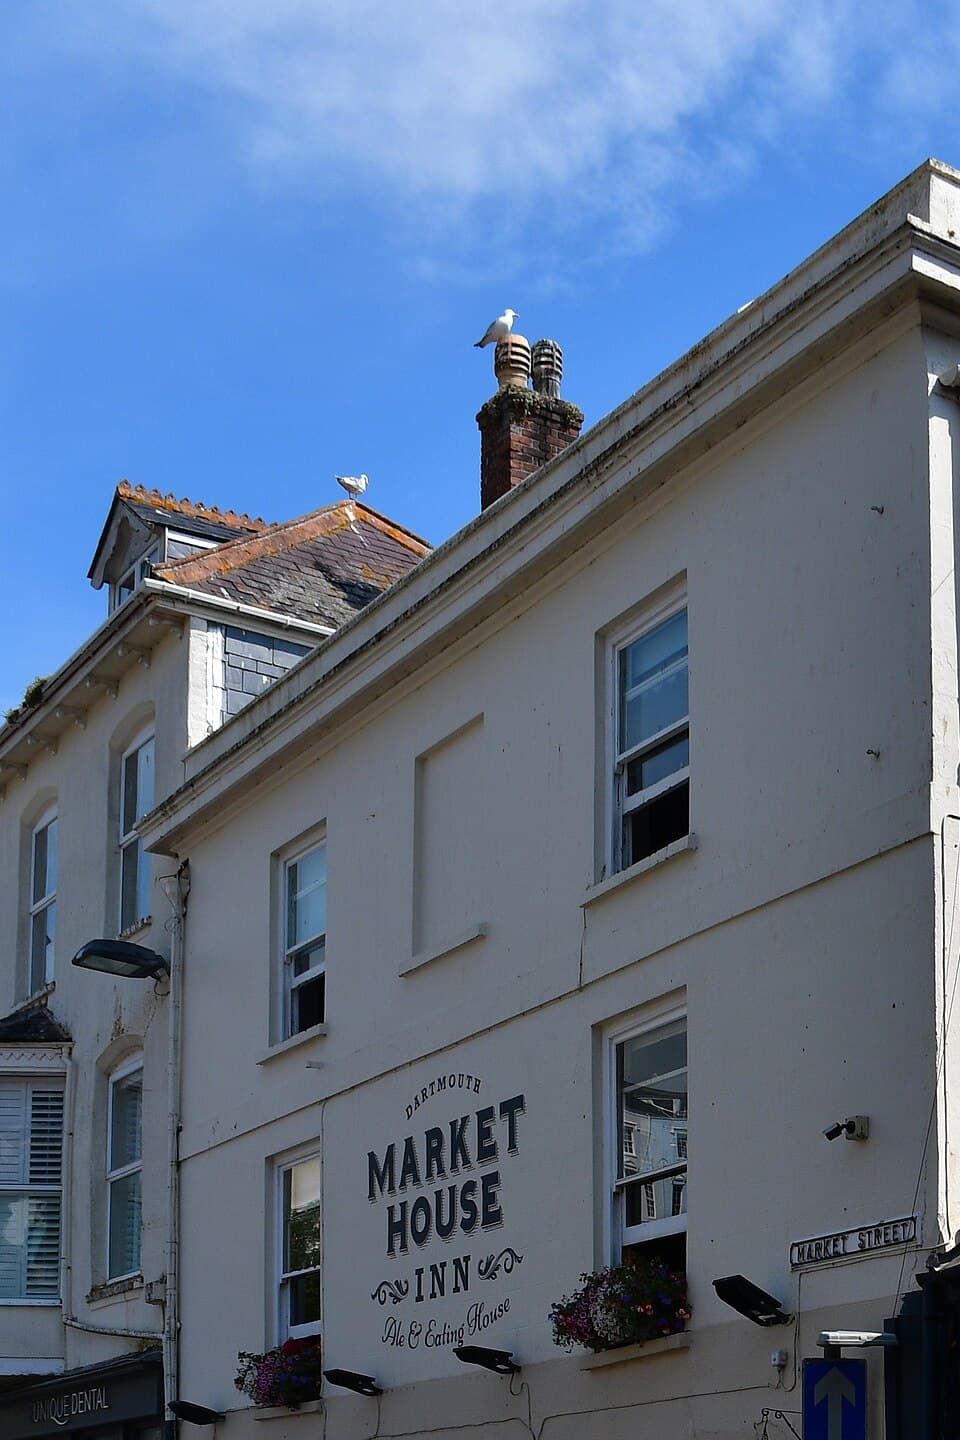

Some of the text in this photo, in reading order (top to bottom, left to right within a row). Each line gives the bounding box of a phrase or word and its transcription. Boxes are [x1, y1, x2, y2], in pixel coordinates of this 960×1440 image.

[405, 1073, 482, 1121] DARTMOUTH
[367, 1094, 527, 1203] MARKET
[387, 1171, 504, 1259] HOUSE
[797, 1221, 911, 1262] MARKET STREET
[415, 1255, 471, 1302] INN
[382, 1297, 510, 1349] Ale & Eating House
[32, 1386, 109, 1426] UNIQUE DENTAL
